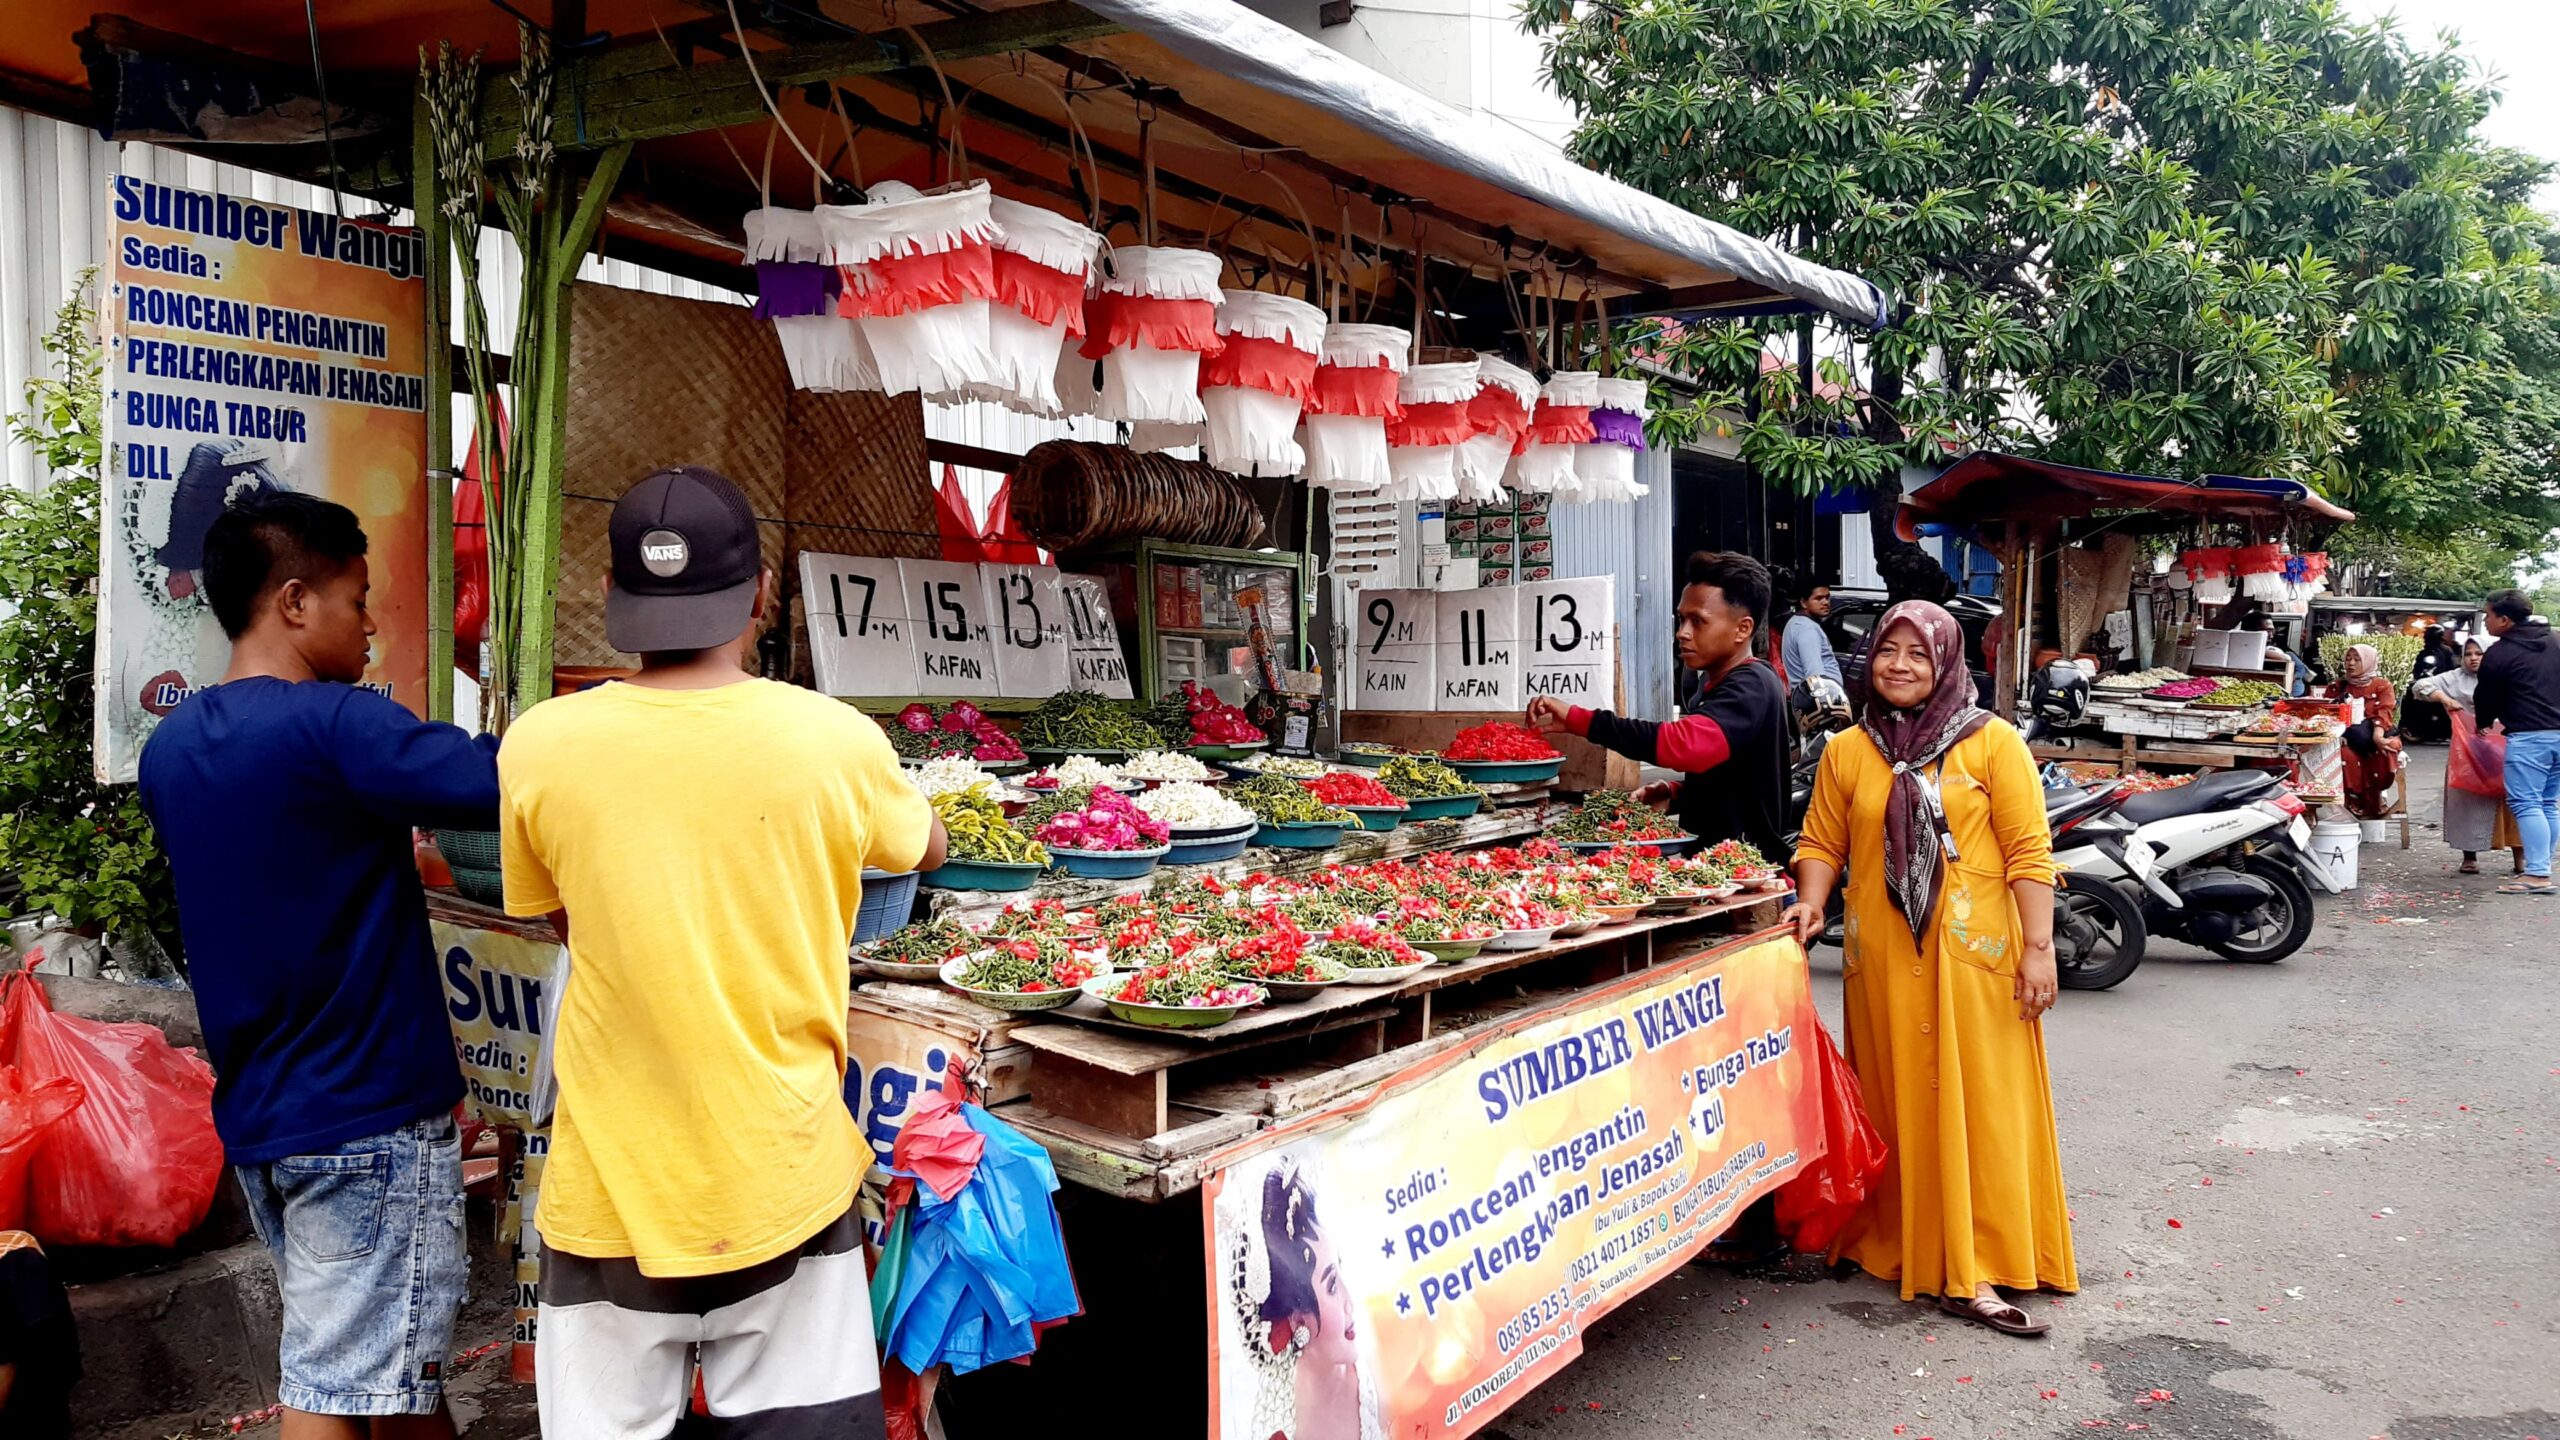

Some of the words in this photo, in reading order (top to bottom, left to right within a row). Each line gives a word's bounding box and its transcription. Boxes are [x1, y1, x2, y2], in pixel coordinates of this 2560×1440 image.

[114, 175, 290, 251] Sumber
[297, 208, 425, 278] Wangi
[122, 236, 207, 278] Sedia
[127, 286, 250, 338] RONCEAN
[256, 306, 386, 358] PENGANTIN
[127, 338, 321, 396] PERLENGKAPAN
[327, 369, 424, 410] JENASAH
[127, 391, 219, 433] BUNGA
[225, 402, 307, 443] TABUR
[127, 443, 173, 480] DLL
[643, 544, 684, 561] VANS
[923, 651, 982, 681] KAFAN
[1365, 669, 1407, 692] KAIN
[1446, 678, 1499, 698] KAFAN
[1526, 671, 1589, 696] KAFAN
[2330, 845, 2345, 867] A
[1478, 1018, 1632, 1124] SUMBER
[1633, 977, 1725, 1050] WANGI
[1695, 1052, 1745, 1095] Bunga
[1746, 1028, 1790, 1066] Tabur
[1702, 1099, 1724, 1135] Dll
[1405, 1169, 1536, 1262] Roncean
[1533, 1106, 1647, 1178] engantin
[1597, 1129, 1684, 1199] Jenasah
[1385, 1169, 1437, 1215] Sedia
[1594, 1215, 1610, 1233] Ibu
[1611, 1200, 1630, 1223] Yuli
[1640, 1181, 1668, 1208] Bapak
[1571, 1250, 1599, 1283] 0821
[1600, 1234, 1628, 1264] 4071
[1629, 1218, 1655, 1248] 1857
[1599, 1262, 1638, 1293] Surabaya
[1643, 1247, 1667, 1264] Buka
[1498, 1319, 1521, 1353] 085
[1522, 1307, 1540, 1339] 85
[1541, 1293, 1560, 1321] 25
[1461, 1356, 1525, 1411] WONOREJO
